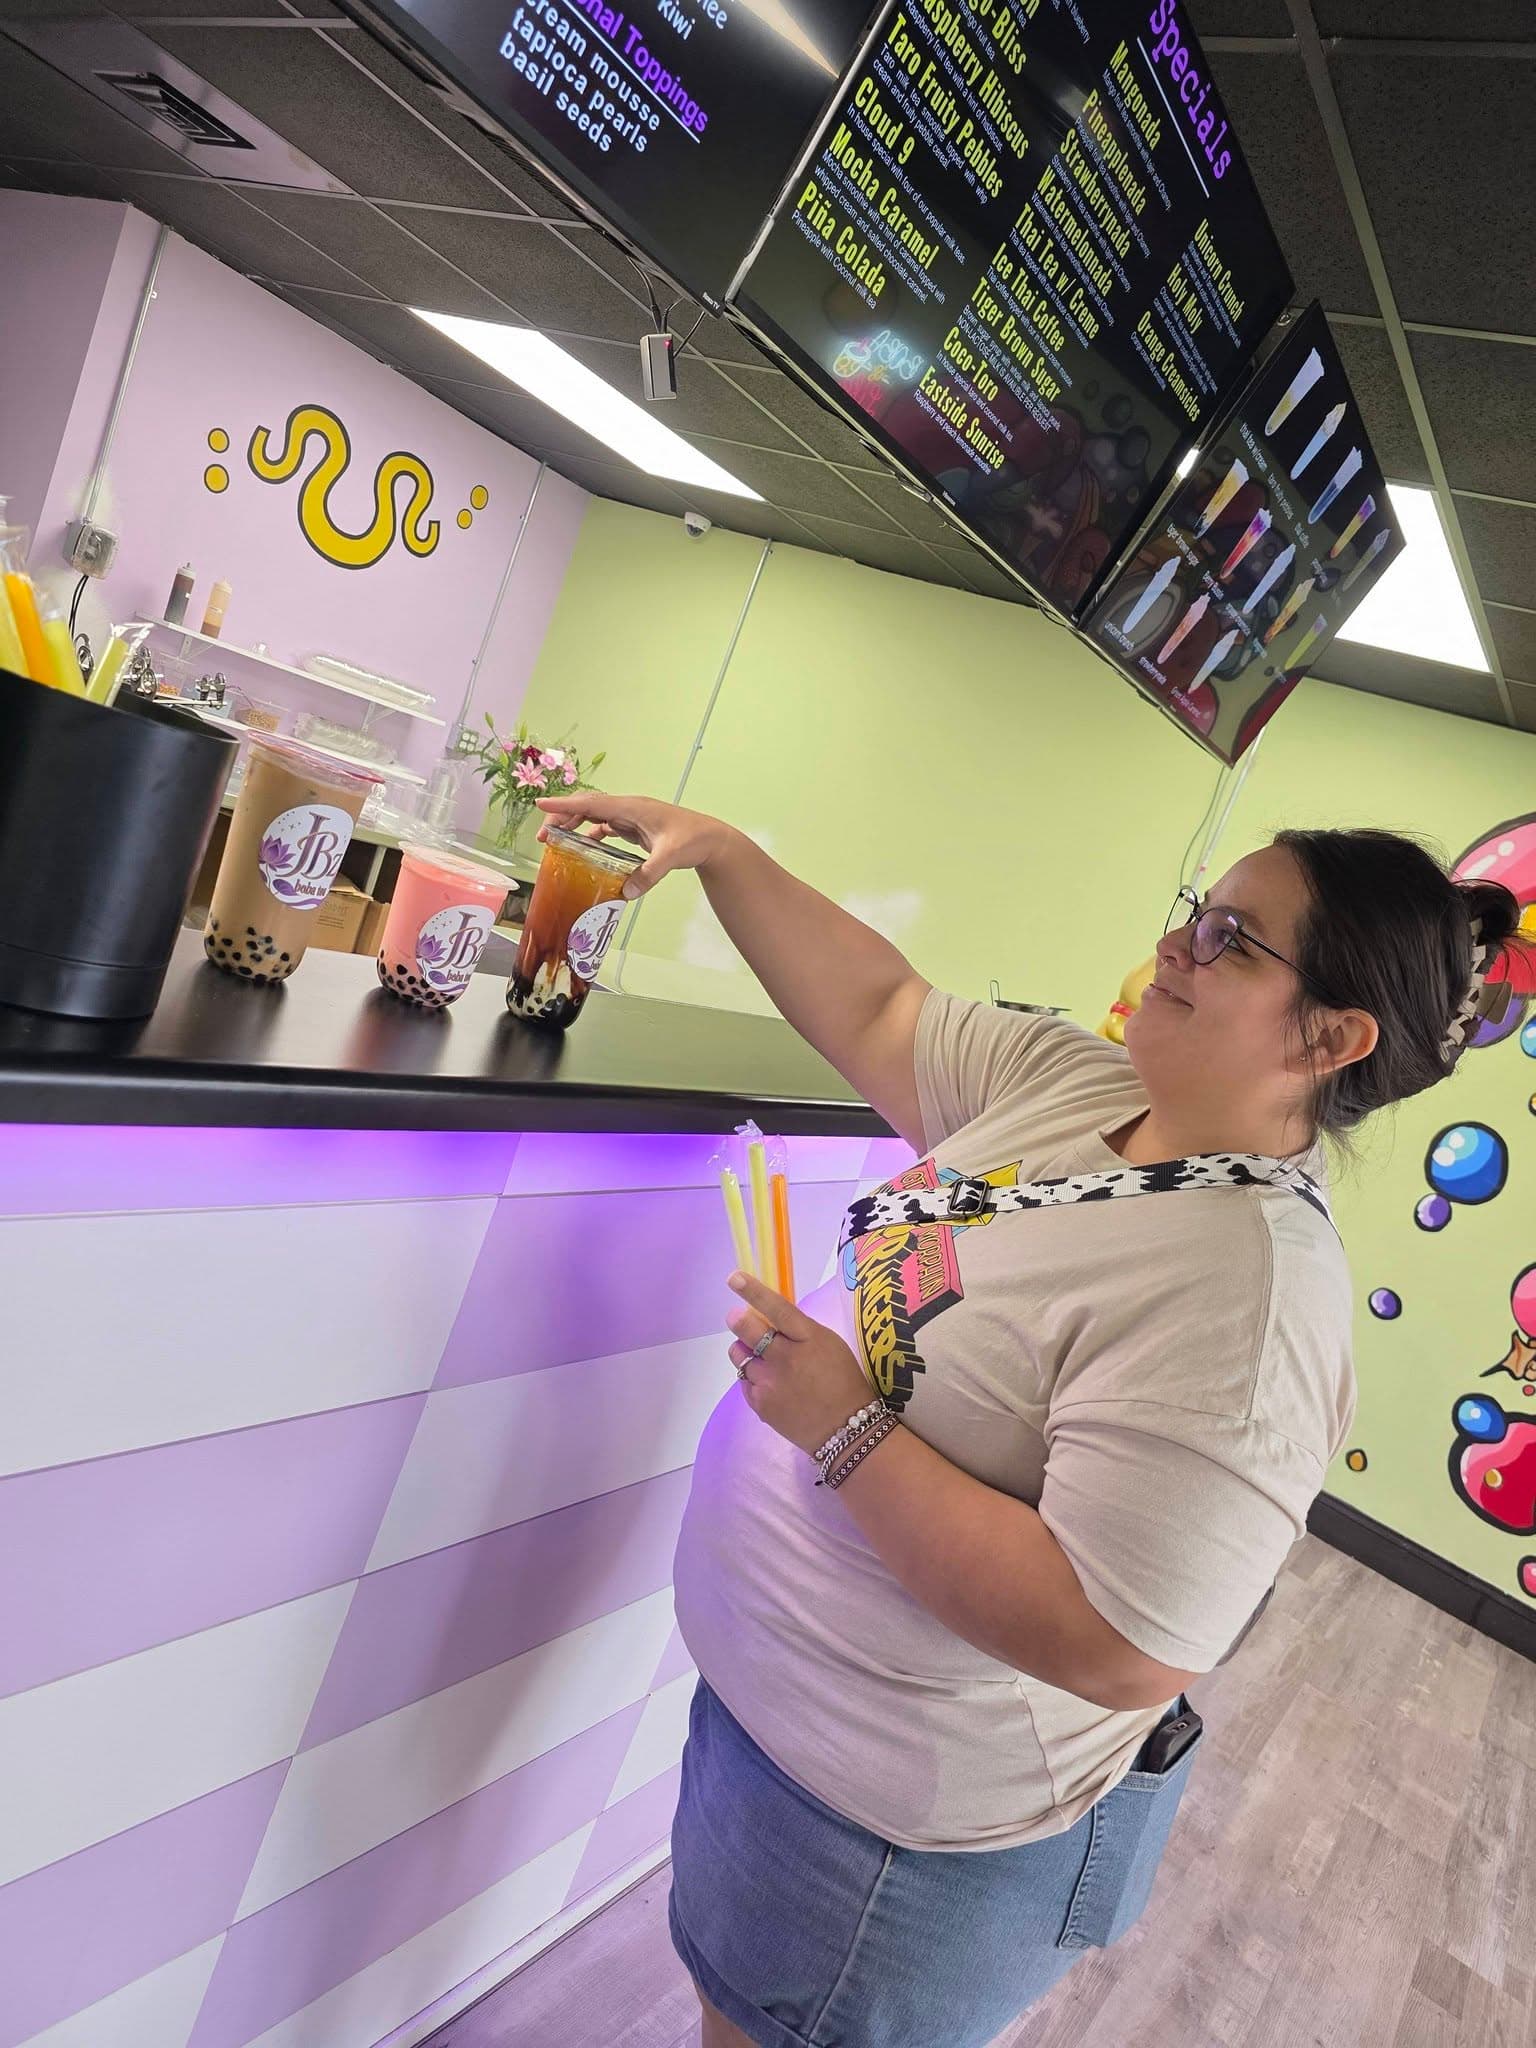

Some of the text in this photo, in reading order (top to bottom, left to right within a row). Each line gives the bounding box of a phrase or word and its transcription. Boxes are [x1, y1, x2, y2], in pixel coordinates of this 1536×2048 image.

[657, 0, 696, 41] kiwi
[975, 24, 988, 47] fruit
[499, 31, 556, 97] basil
[555, 91, 613, 153] seeds
[511, 6, 589, 96] tapioca
[588, 89, 649, 153] pearls
[588, 52, 661, 131] mousse
[623, 23, 710, 133] Toppings
[854, 76, 915, 165] Cloud 9
[872, 58, 950, 170] cream and fruity pebble cereal.
[879, 43, 988, 204] Taro milk tea smoothie topped with whip
[885, 12, 1004, 197] Taro Fruity Pebbles
[932, 38, 946, 62] fruit
[942, 55, 954, 75] tea
[951, 70, 965, 92] with
[962, 87, 969, 98] a
[966, 92, 978, 112] hint
[974, 107, 984, 120] of
[978, 70, 1030, 159] Hibiscus
[1109, 41, 1162, 149] Mangonada
[1149, 0, 1232, 180] Specials
[829, 123, 939, 269] Mocha Caramel
[846, 102, 966, 264] In house special with four of our popular milk teas.
[1059, 128, 1131, 258] Strawberrynada
[1081, 90, 1146, 214] Pineapplenada
[790, 209, 877, 309] Pineapple with Coconut milk tea
[797, 180, 886, 296] Piña Colada
[813, 164, 928, 304] whipped cream and salted chocolate caramel.
[821, 149, 945, 304] Mocha smoothie with a hint of caramel topped with
[1014, 202, 1100, 339] Thai Tea w/ Creme
[1037, 166, 1113, 295] Watermelonnada
[1076, 198, 1086, 215] tea
[1097, 234, 1107, 250] with
[1193, 218, 1244, 321] Unicorn Crunch
[970, 276, 1061, 402] Tiger Brown Sugar
[991, 242, 1065, 351] Ice Thai Coffee
[1165, 262, 1203, 334] Holy Moly
[919, 365, 1005, 469] Eastside Sunrise
[942, 326, 999, 401] Coco-Toro
[953, 371, 971, 392] special
[975, 396, 986, 410] and
[956, 315, 990, 359] NON-LACTOSE
[988, 353, 1001, 371] MILK
[998, 366, 1006, 377] IS
[1022, 396, 1033, 411] PER
[1136, 310, 1201, 422] Orange Creamsicles
[913, 388, 991, 475] Raspberry and peach lemonade smoothie
[294, 878, 317, 897] boba
